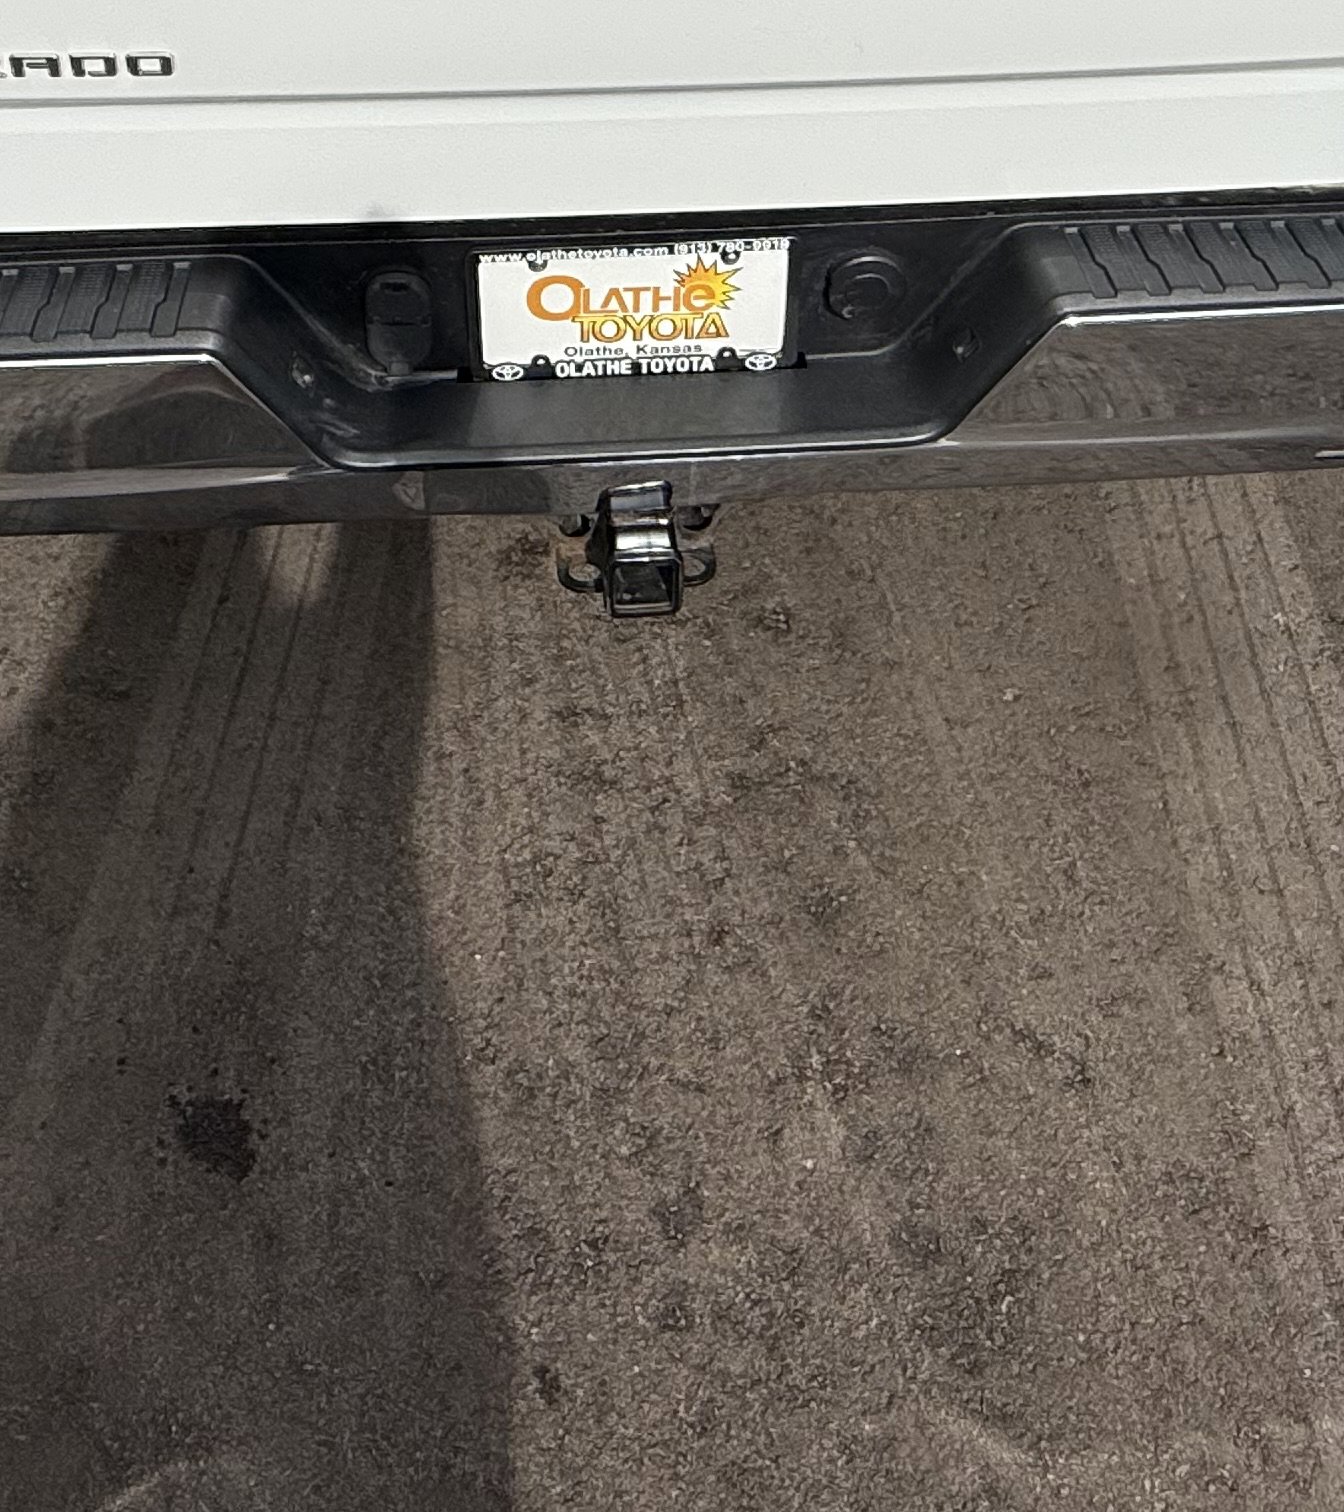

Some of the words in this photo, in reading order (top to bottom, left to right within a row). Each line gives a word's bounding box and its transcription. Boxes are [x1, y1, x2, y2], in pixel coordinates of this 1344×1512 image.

[479, 245, 668, 263] www.olathetoyota.com
[571, 312, 729, 343] TOYOTA
[636, 344, 703, 355] Kansas
[555, 359, 632, 378] OLATHE
[639, 356, 715, 375] TOYOTA
